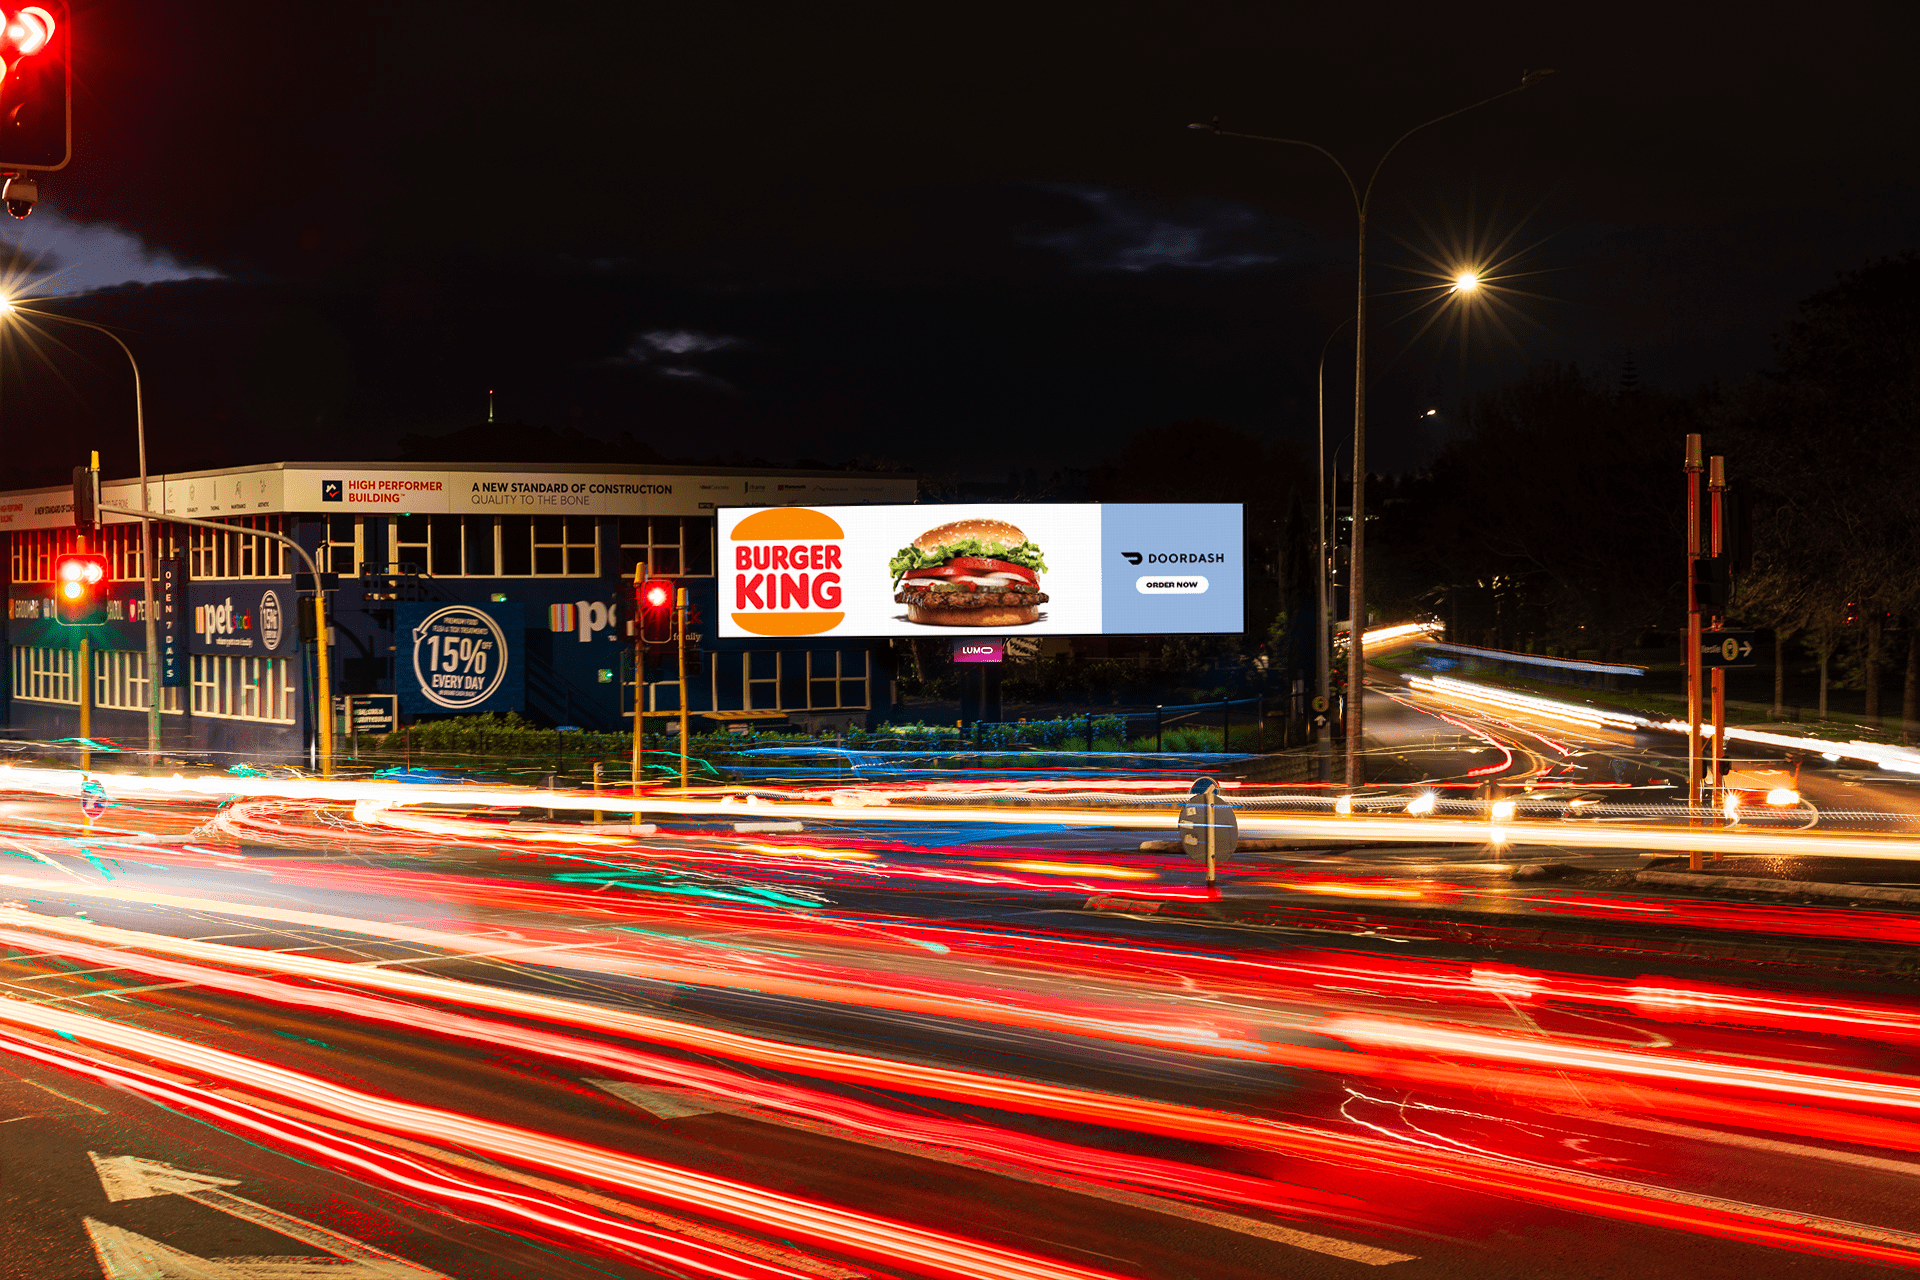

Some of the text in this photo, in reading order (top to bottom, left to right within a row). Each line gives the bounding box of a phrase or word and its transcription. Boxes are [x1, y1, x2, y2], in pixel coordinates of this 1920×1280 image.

[348, 480, 443, 491] HIGH PERFORMER
[472, 482, 672, 494] A NEW STANDARD OF CONSTRUCTION
[471, 494, 590, 505] QUALITY TO THE BONE
[736, 544, 843, 570] BURGER
[1148, 553, 1225, 564] DOORDASH
[1146, 581, 1198, 589] ORDER NOW
[735, 572, 842, 610] KING
[165, 621, 172, 630] 7
[481, 641, 493, 650] OFF
[962, 646, 994, 655] LUMO
[165, 635, 174, 678] DAYS
[427, 635, 487, 674] 15%
[431, 673, 486, 690] EVERY DAY
